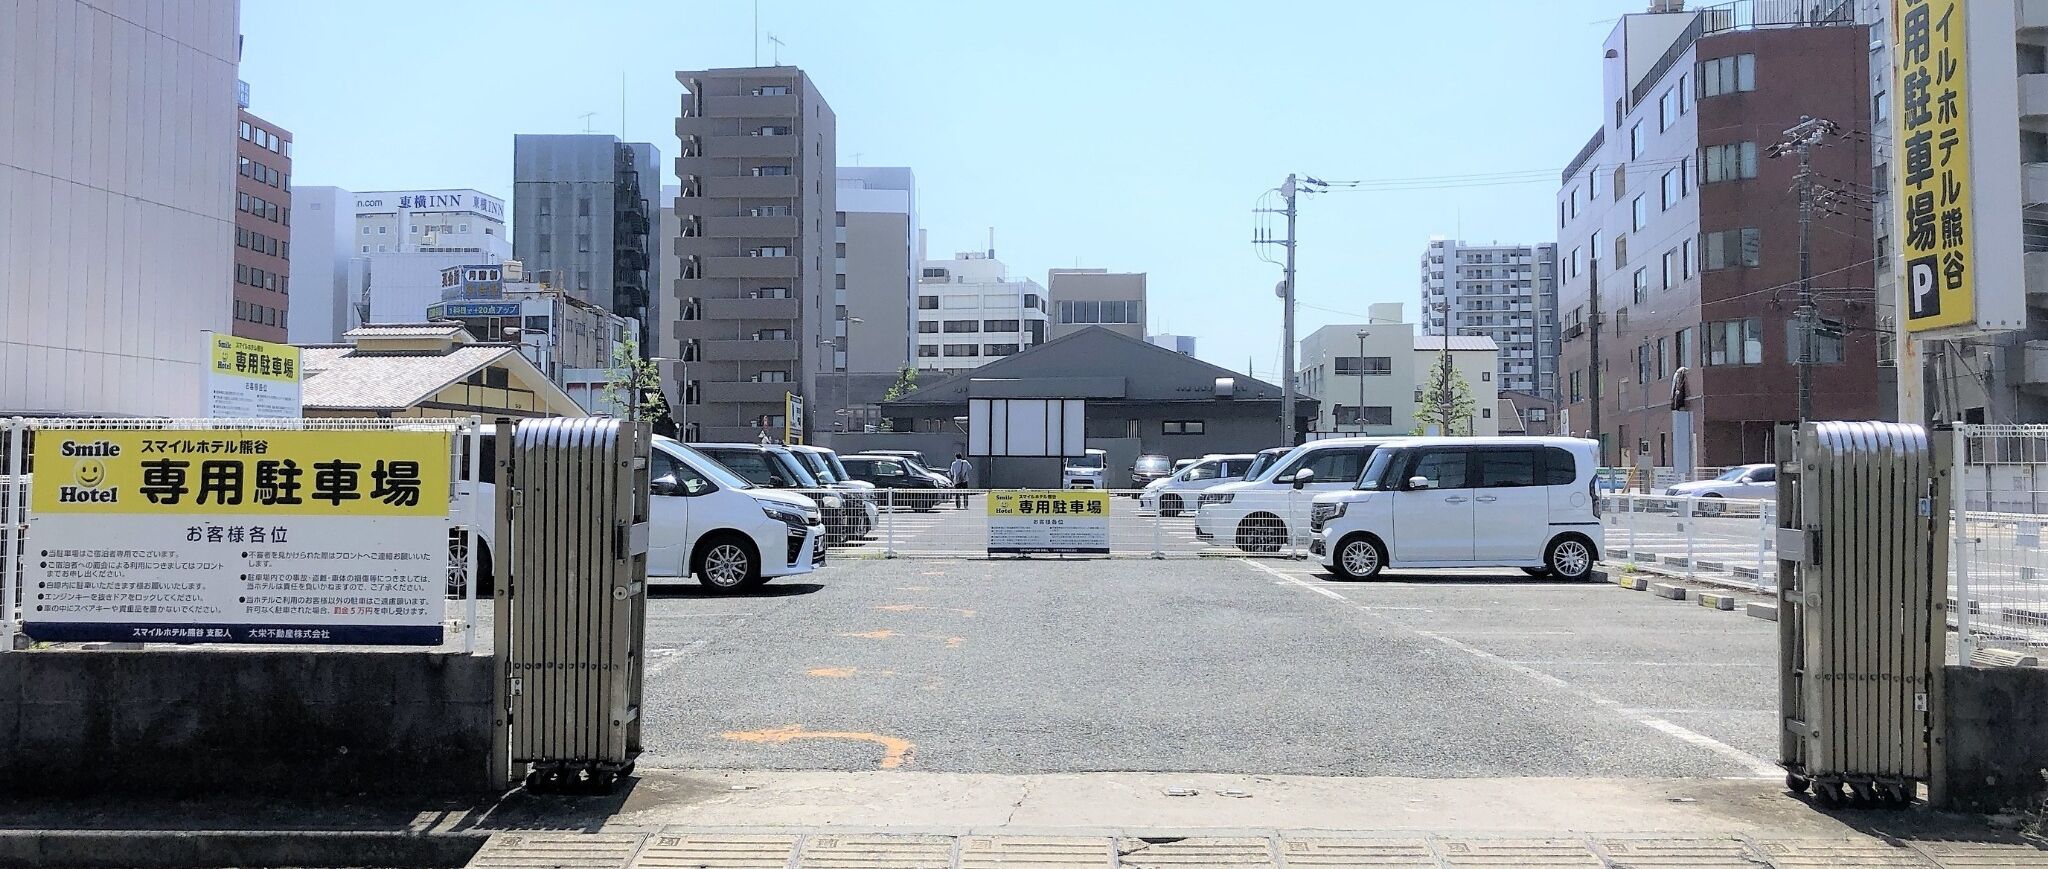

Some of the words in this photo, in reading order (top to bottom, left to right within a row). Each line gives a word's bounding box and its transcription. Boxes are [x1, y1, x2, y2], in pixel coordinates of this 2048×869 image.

[1903, 0, 1937, 251] 用駐車場
[1913, 263, 1933, 313] P
[218, 340, 231, 349] Smile
[217, 361, 231, 370] Hotel
[236, 351, 294, 378] 専用駐車場
[62, 441, 120, 457] Smile
[141, 440, 269, 455] スマイルホテル熊谷
[140, 458, 421, 507] 専用駐車場
[60, 487, 117, 503] Hotel
[1019, 500, 1102, 514] 専用駐車場
[186, 525, 289, 544] お客様各位
